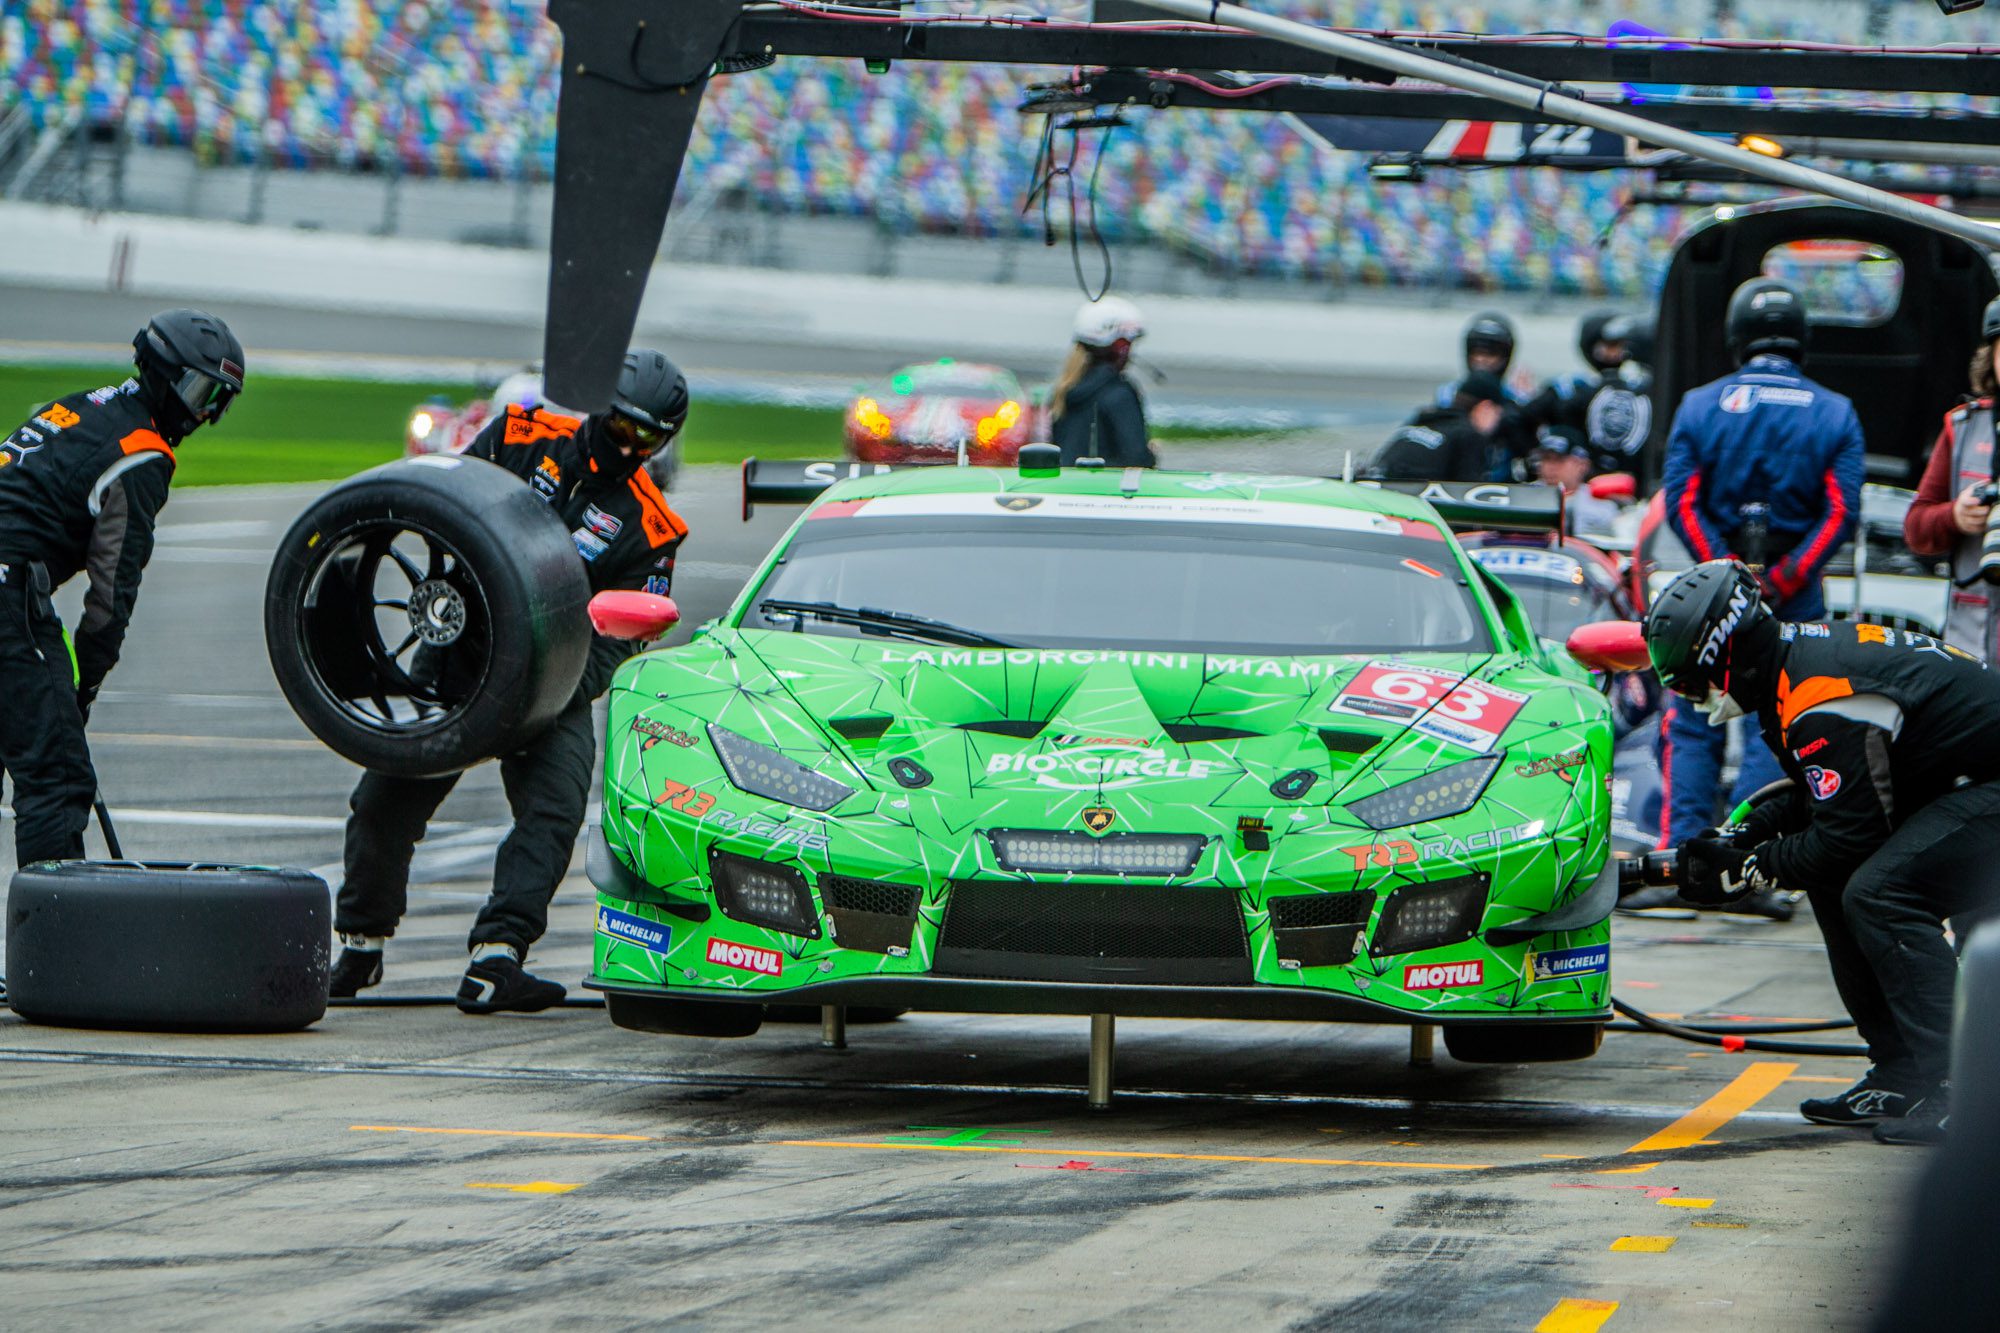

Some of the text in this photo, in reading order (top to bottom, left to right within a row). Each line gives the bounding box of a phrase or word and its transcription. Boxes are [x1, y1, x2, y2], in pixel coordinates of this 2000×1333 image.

[511, 423, 533, 437] OMP
[881, 650, 1336, 678] LAMBORGHINI MIAMI
[1371, 671, 1490, 722] 63
[1083, 737, 1149, 746] IMSA
[1799, 738, 1829, 759] IMSA
[986, 753, 1212, 779] BIO-CIRCLE
[653, 777, 832, 850] TR3 RACING
[1339, 839, 1419, 871] TR3
[610, 917, 663, 944] MICHELIN
[708, 941, 780, 973] MOTUL
[1552, 953, 1606, 971] MICHELIN
[1406, 963, 1481, 988] MOTUL
